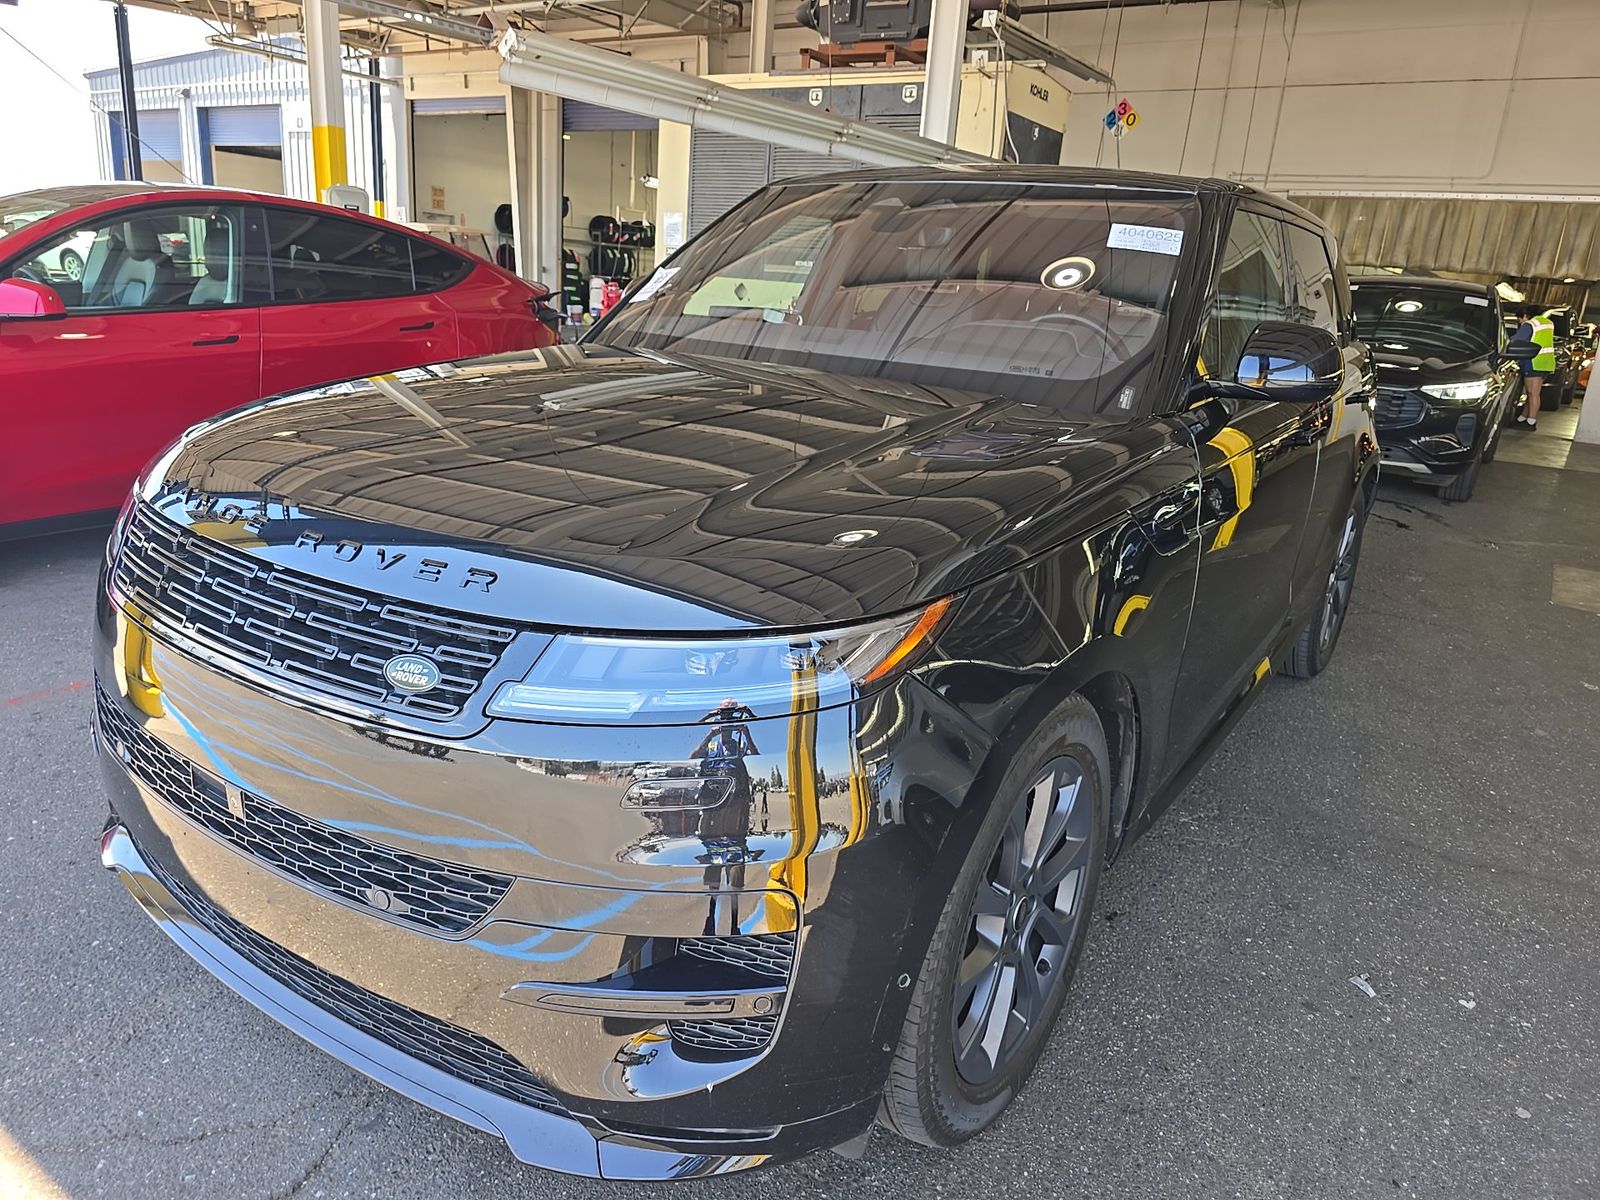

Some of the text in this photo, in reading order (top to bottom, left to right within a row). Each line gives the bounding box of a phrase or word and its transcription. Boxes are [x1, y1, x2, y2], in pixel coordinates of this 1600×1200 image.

[1030, 82, 1049, 103] KOHLER
[1117, 102, 1128, 116] 3
[1107, 110, 1136, 126] 2 0
[1118, 226, 1182, 243] 4040625
[293, 529, 500, 593] ROVER
[396, 661, 424, 674] LAND
[395, 671, 429, 686] ROVER
